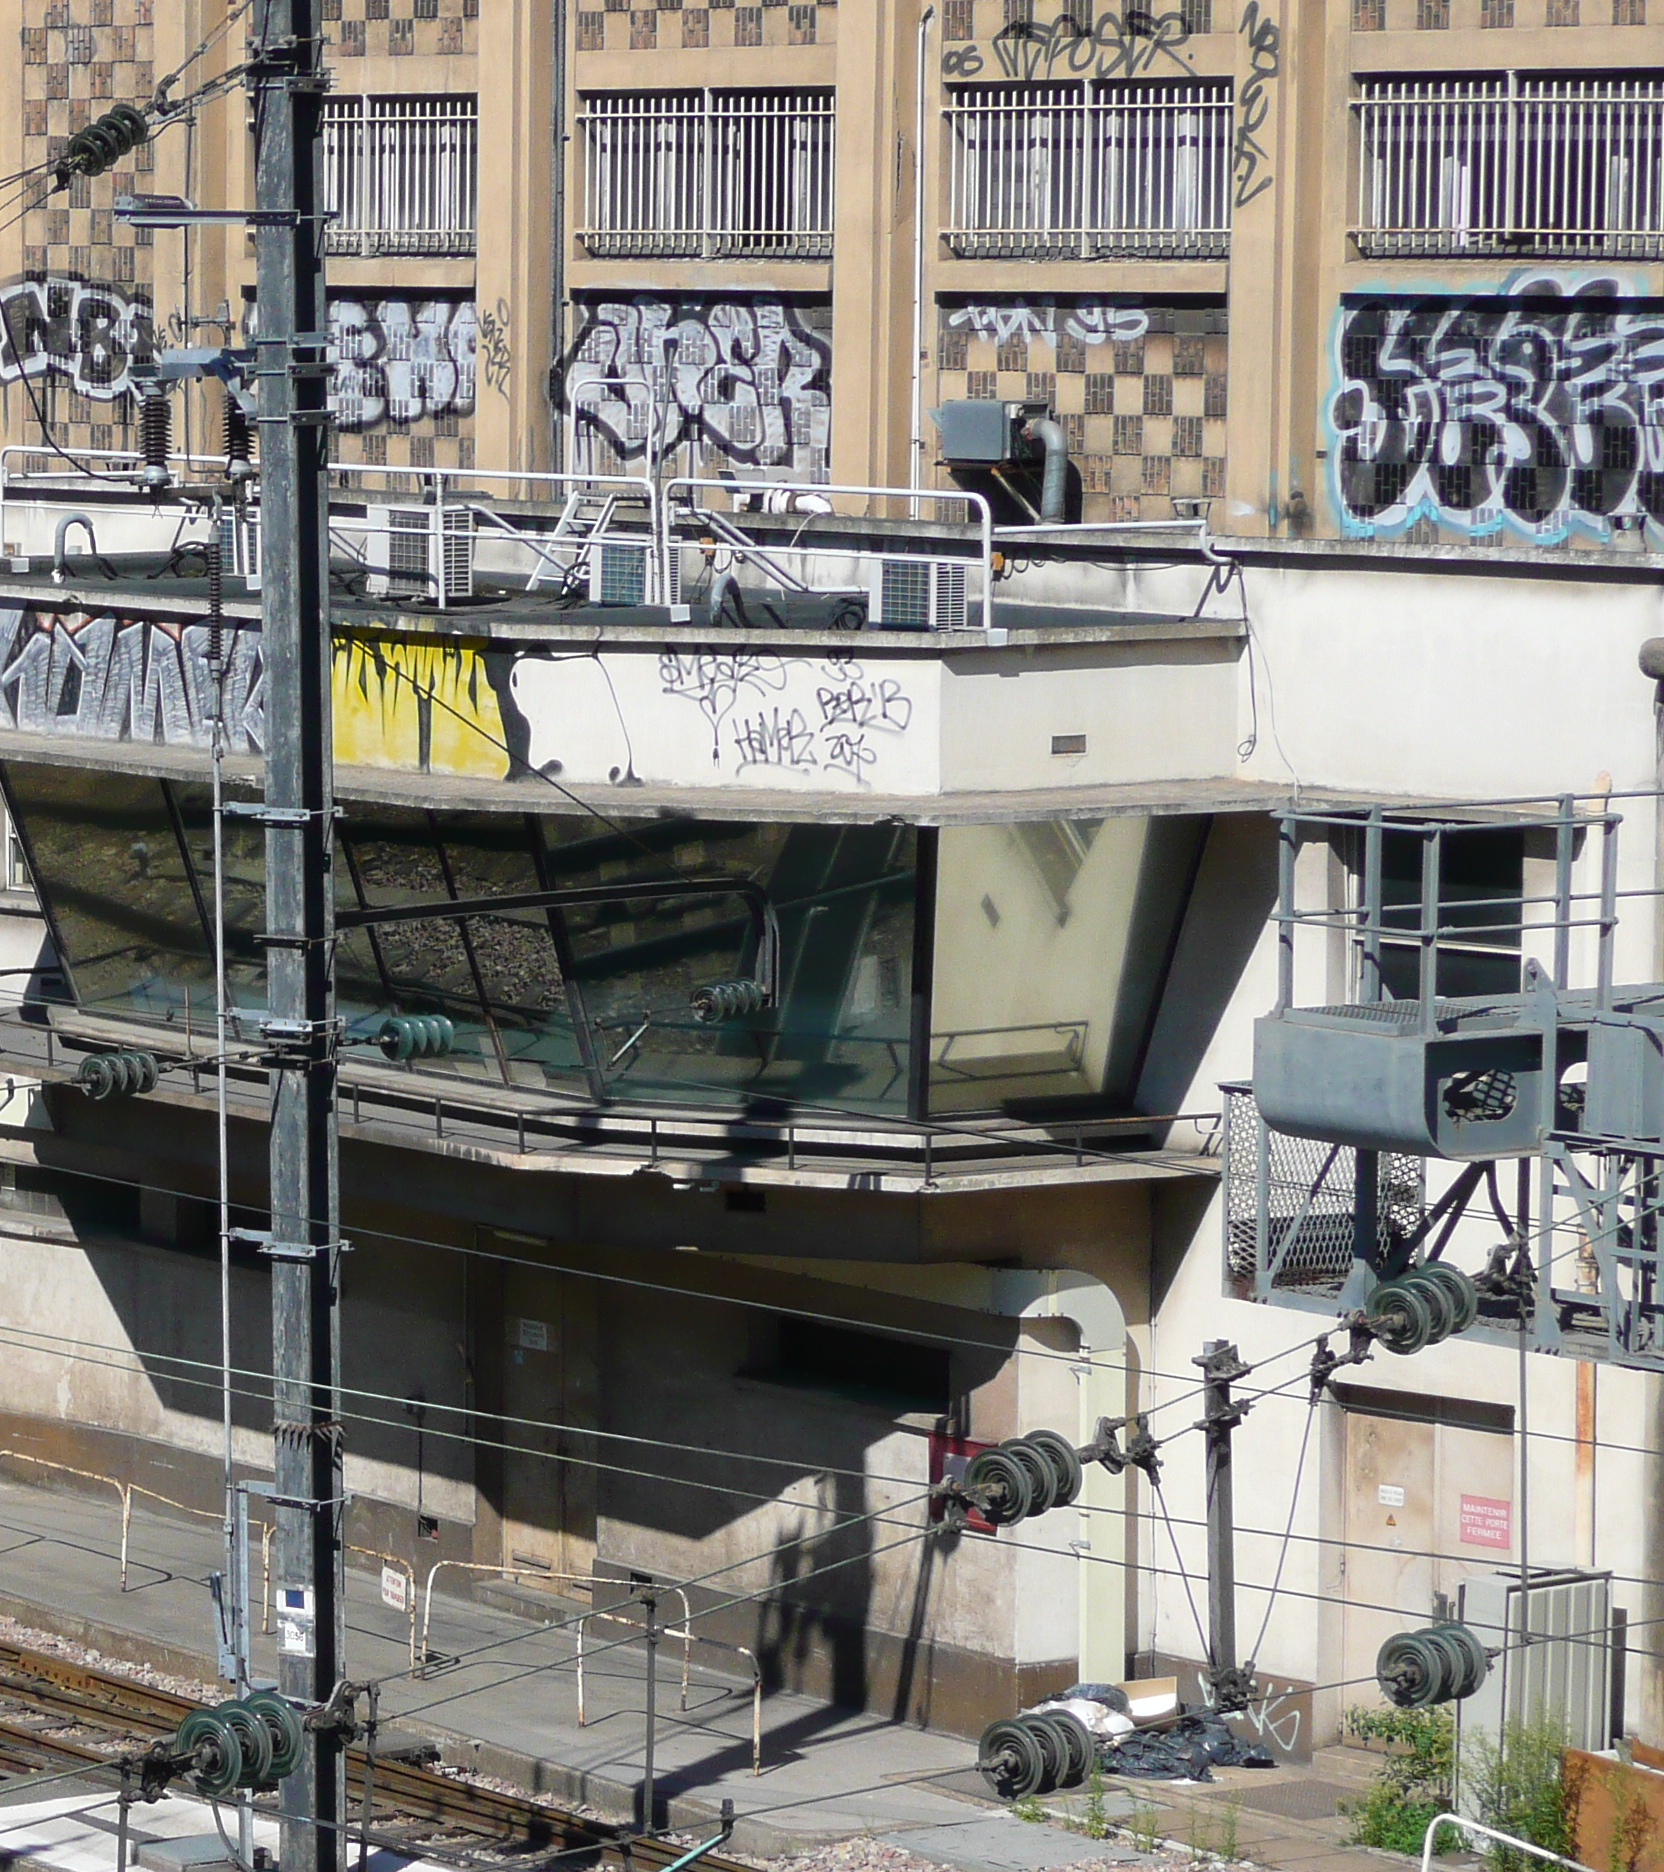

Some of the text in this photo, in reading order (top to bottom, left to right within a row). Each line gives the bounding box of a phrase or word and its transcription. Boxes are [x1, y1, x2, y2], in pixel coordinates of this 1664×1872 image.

[1462, 1503, 1508, 1518] MAINTENIR
[1461, 1514, 1509, 1530] CETTE PORTE
[1466, 1526, 1502, 1540] FERMEE
